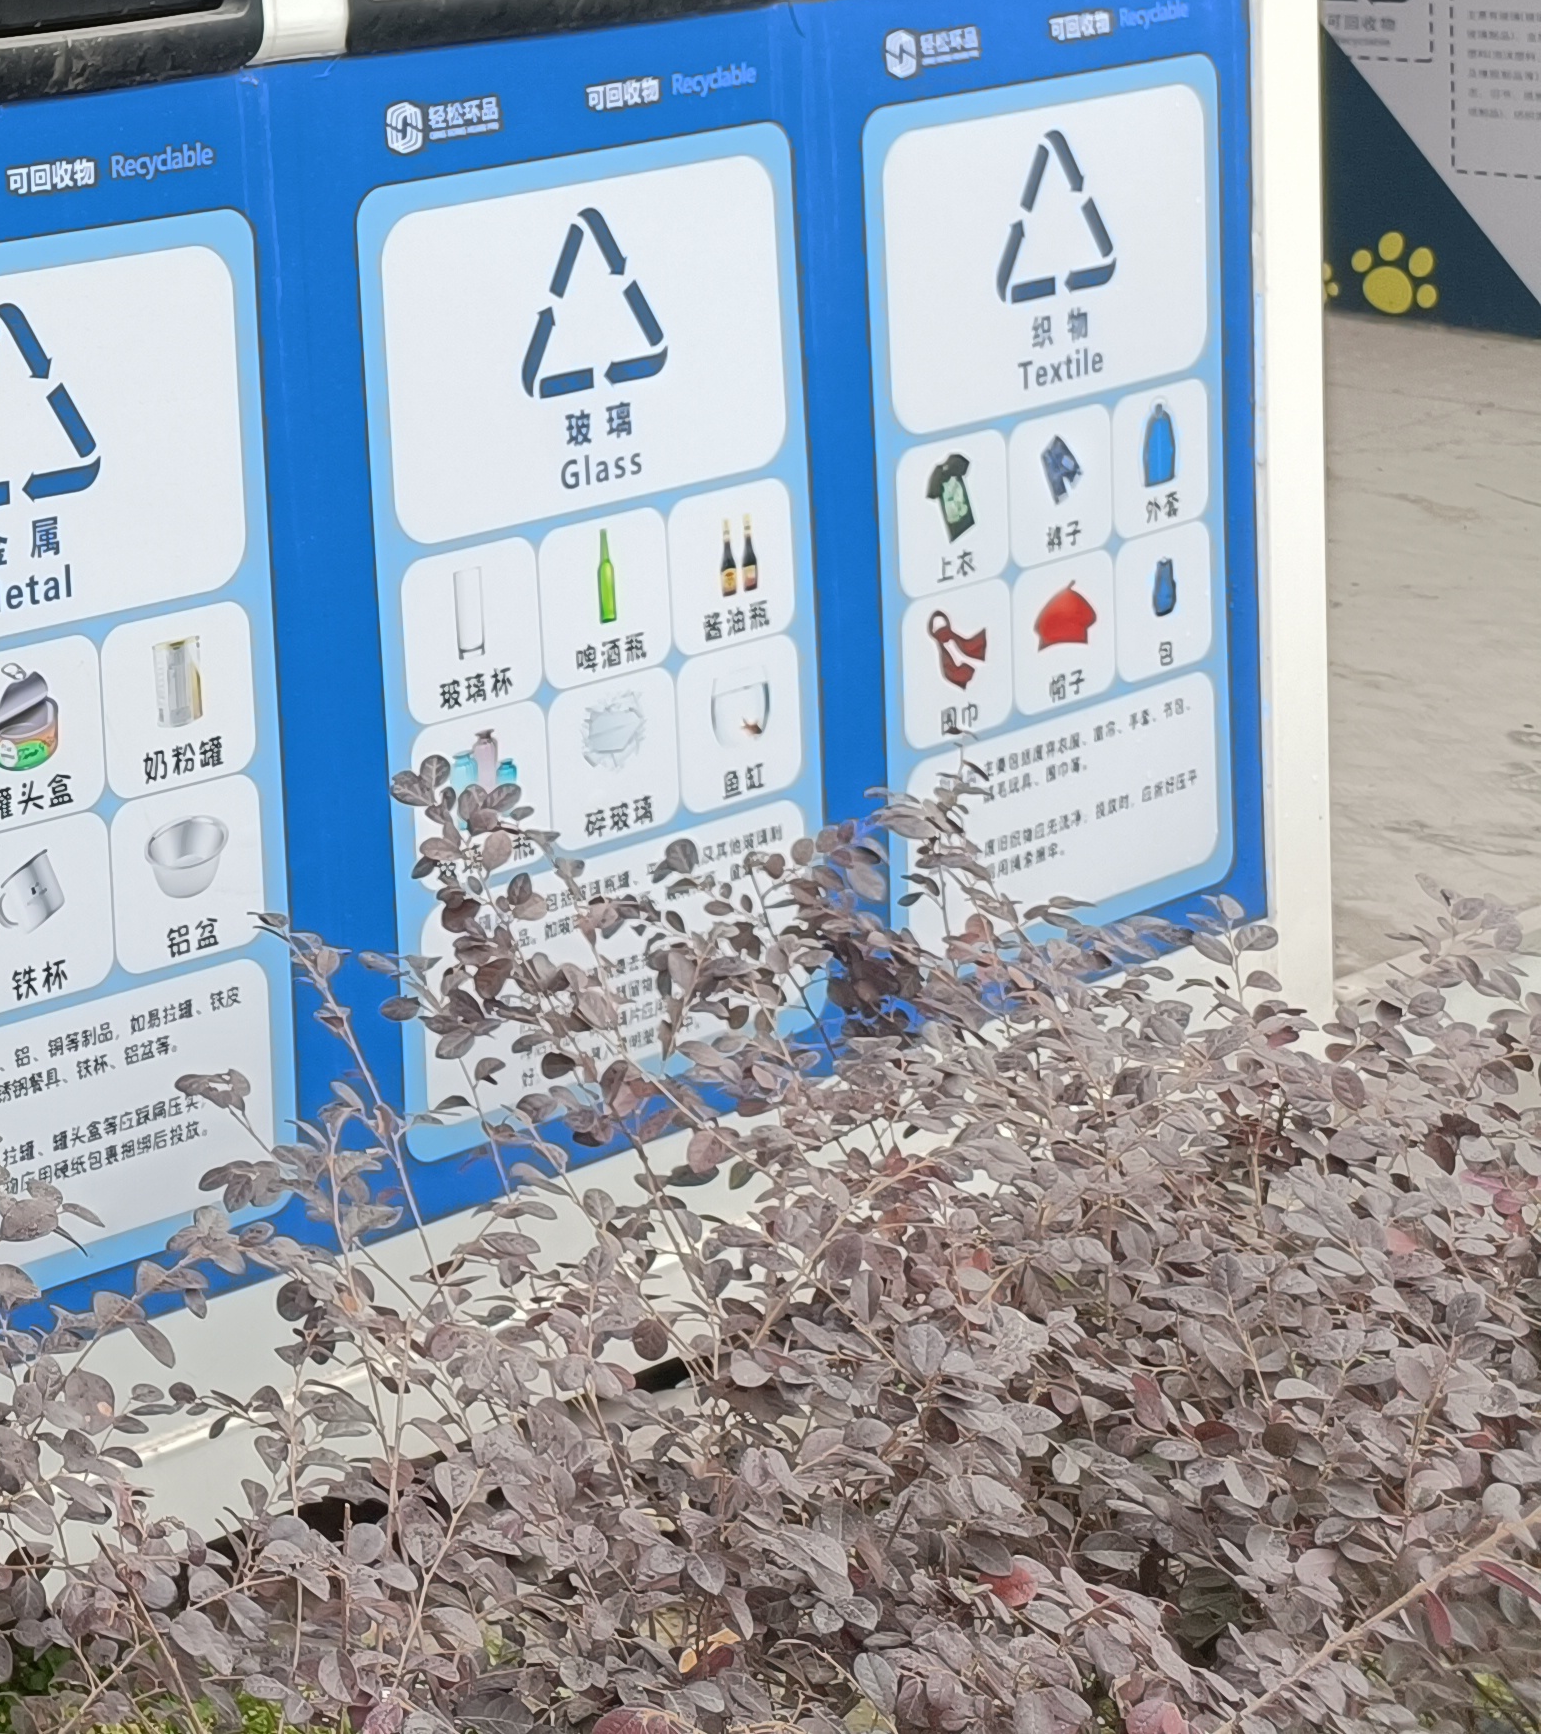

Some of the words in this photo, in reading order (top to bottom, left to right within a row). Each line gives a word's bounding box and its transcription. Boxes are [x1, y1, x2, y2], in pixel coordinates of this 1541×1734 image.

[586, 77, 660, 110] 可回收物
[671, 62, 757, 98] Recyclable
[7, 158, 96, 195] 可回收物
[110, 142, 214, 181] Recyclable
[1032, 307, 1089, 348] 织物
[1018, 348, 1104, 389] Textile
[565, 401, 632, 447] 玻璃
[561, 451, 643, 489] Glass
[937, 550, 976, 583] 上衣
[703, 600, 770, 642] 酱油瓶
[576, 632, 647, 673] 啤酒瓶
[439, 667, 514, 710] 玻璃杯
[1049, 669, 1085, 703] 帽子
[142, 736, 224, 784] 奶粉罐
[723, 763, 765, 799] 鱼缸
[585, 796, 654, 837] 碎玻璃
[166, 918, 220, 958] 铝盆
[12, 959, 68, 1001] 铁杯
